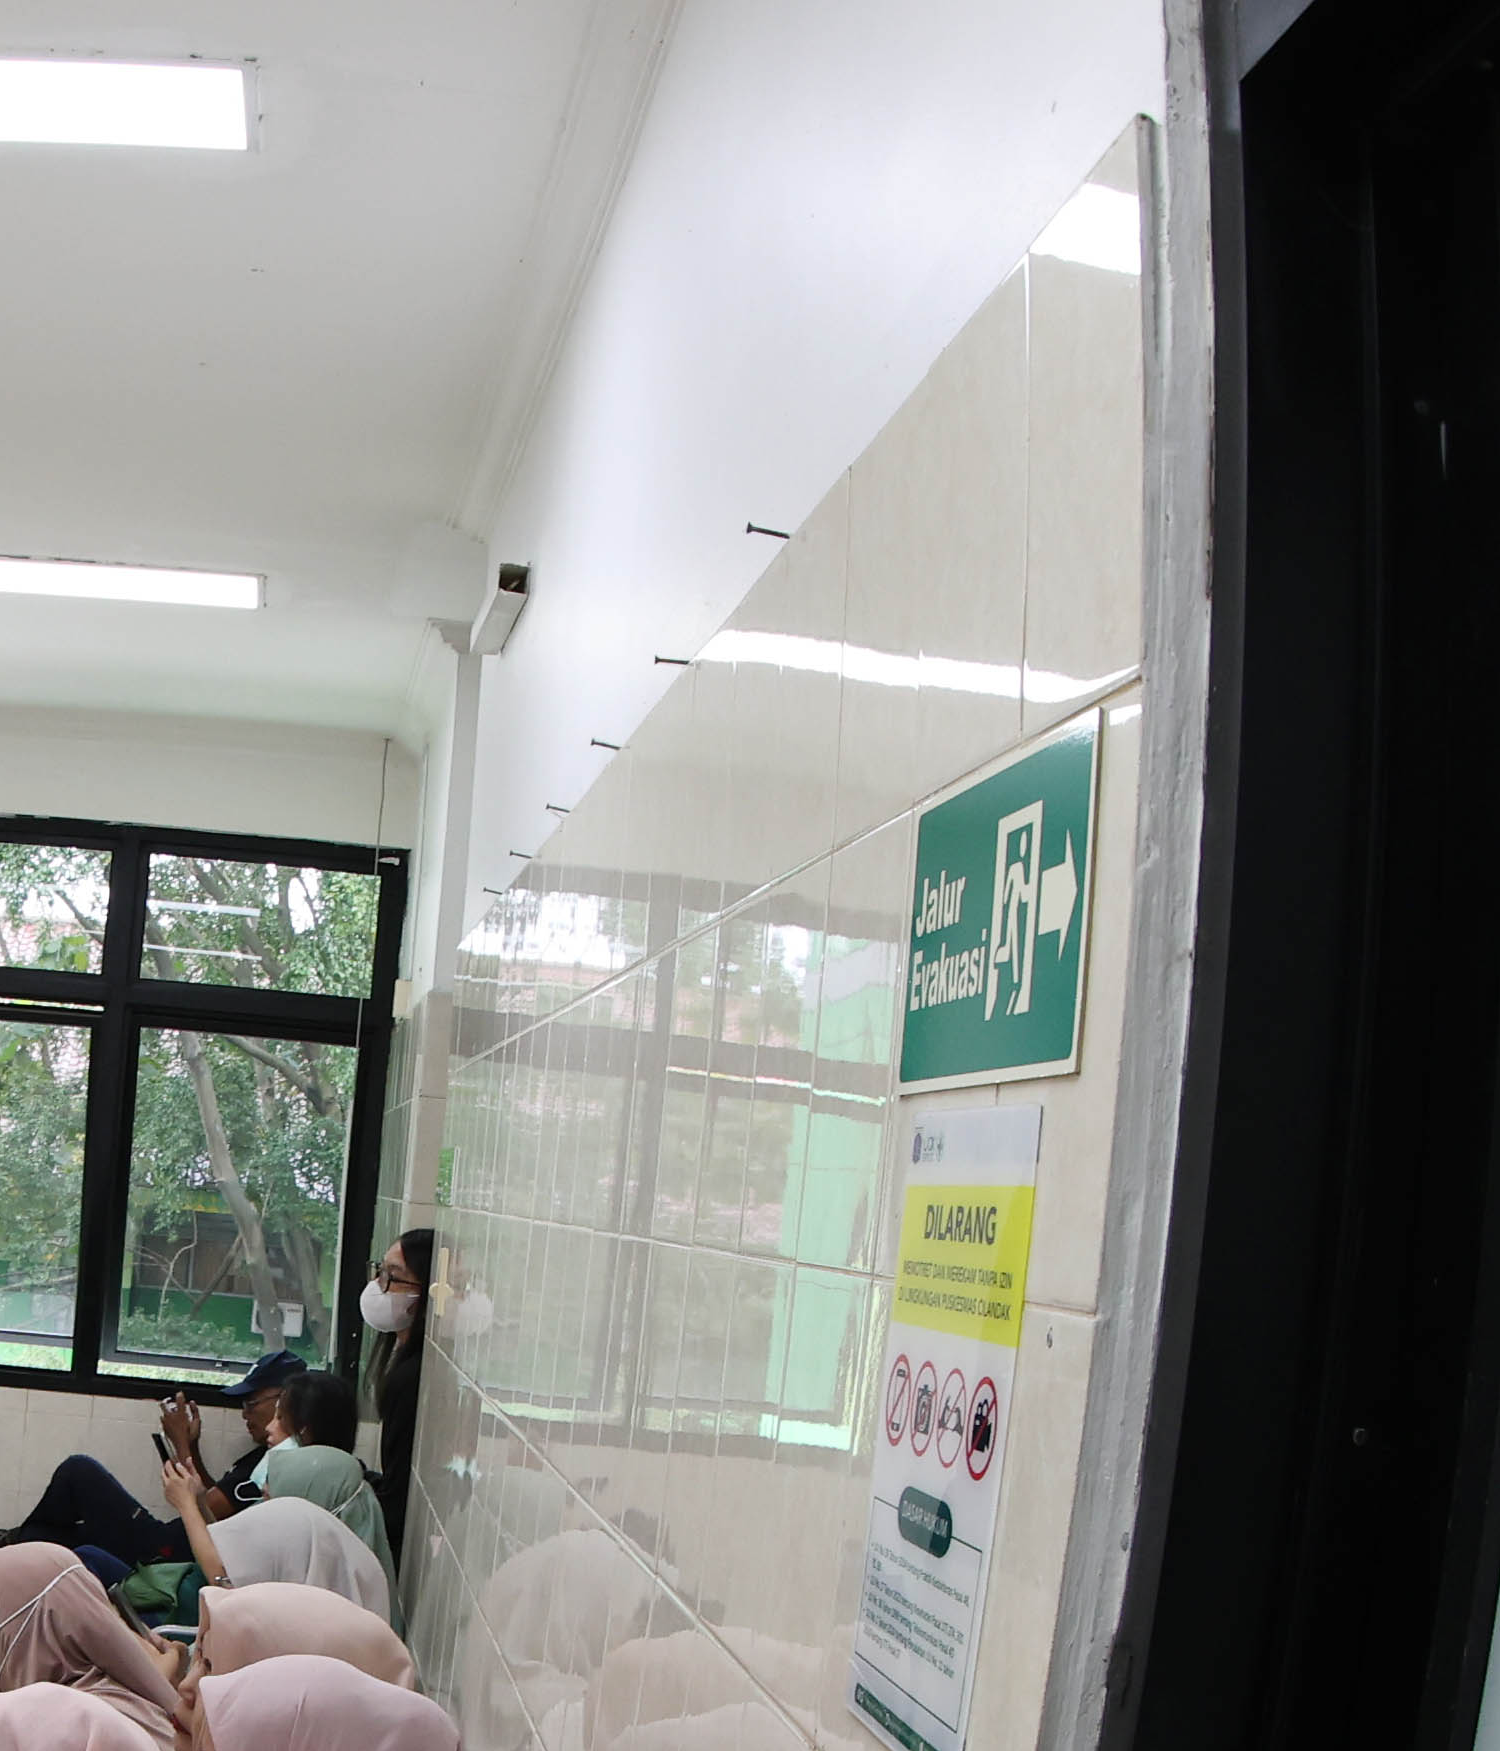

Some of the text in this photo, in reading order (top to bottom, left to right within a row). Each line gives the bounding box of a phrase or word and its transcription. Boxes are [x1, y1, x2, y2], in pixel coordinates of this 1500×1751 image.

[916, 870, 966, 937] Jalur
[910, 928, 987, 1011] Evakuasi
[924, 1204, 997, 1245] DILARANG
[933, 1263, 946, 1280] DAN
[947, 1265, 977, 1284] MEREKAM
[978, 1268, 997, 1287] TANPA
[999, 1271, 1013, 1289] IZIN
[942, 1293, 977, 1315] PUSKESMAS
[978, 1298, 1012, 1320] CILANDAK
